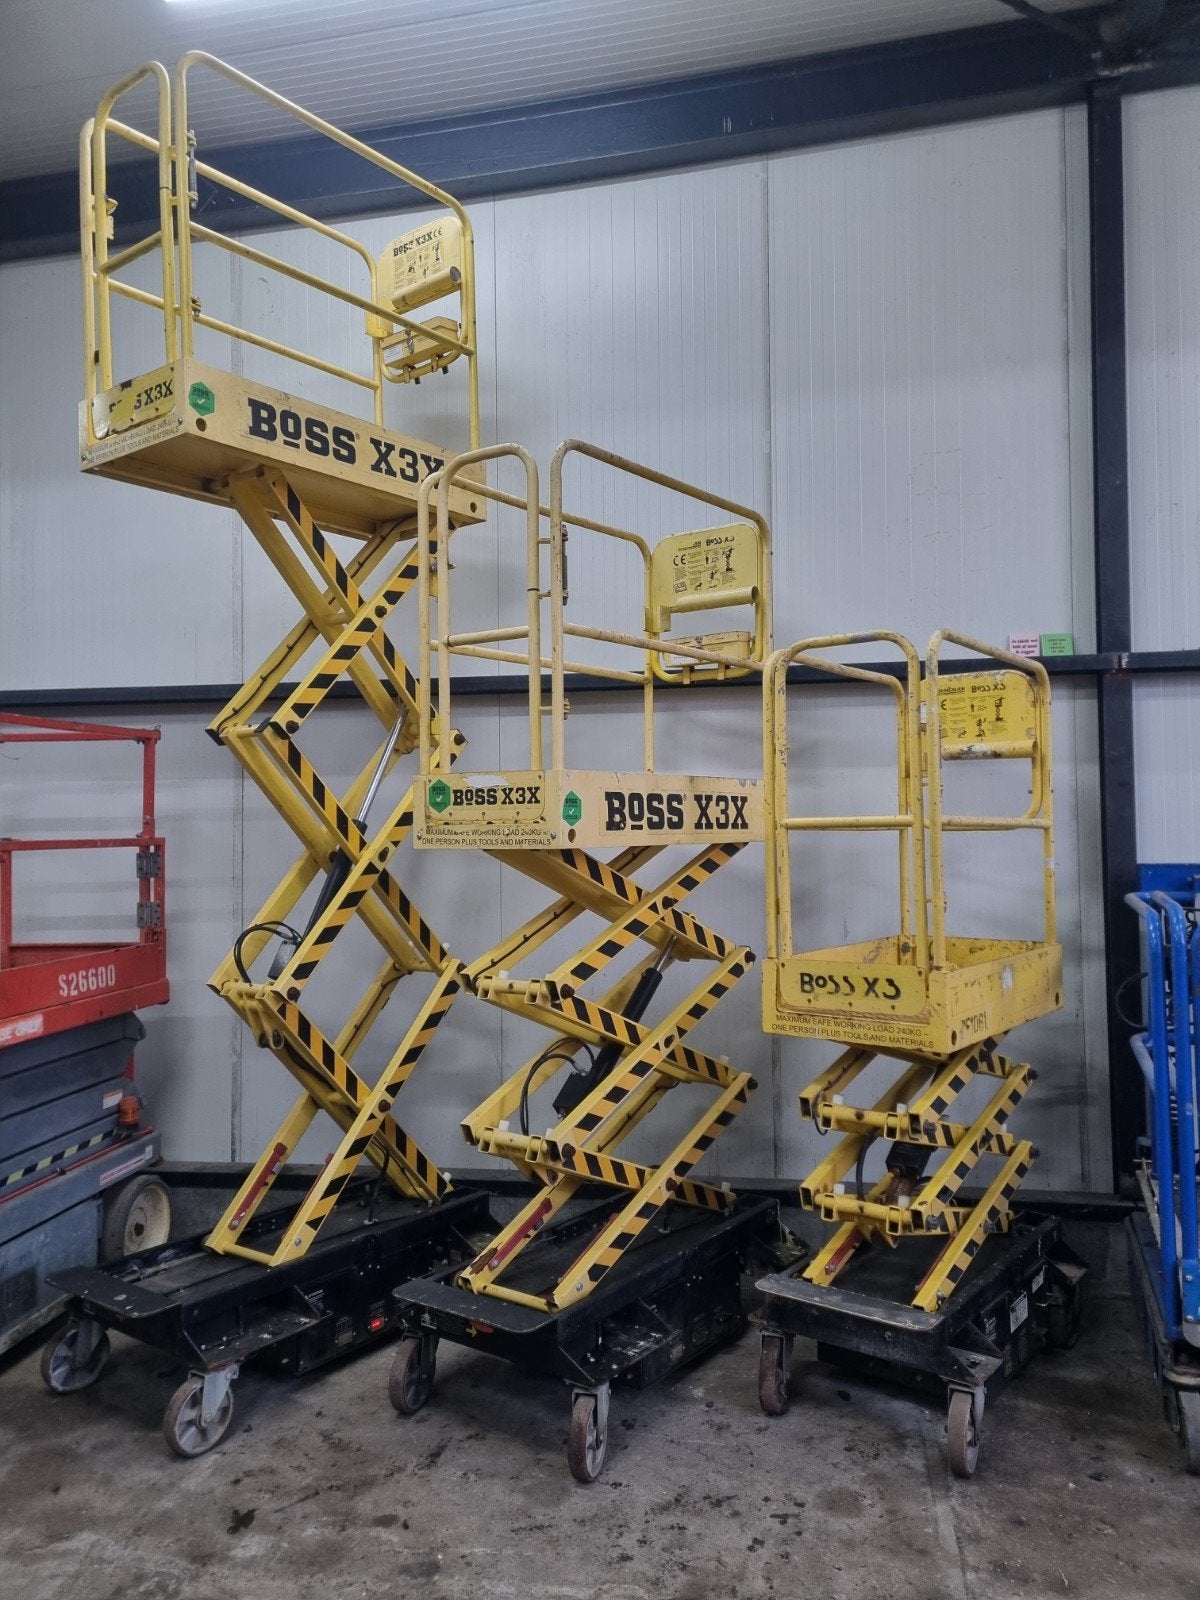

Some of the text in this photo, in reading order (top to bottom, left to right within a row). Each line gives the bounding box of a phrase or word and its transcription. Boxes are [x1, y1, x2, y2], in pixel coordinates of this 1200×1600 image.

[501, 787, 541, 805] X3X
[693, 794, 749, 830] X3X
[461, 838, 478, 846] PLUS
[479, 838, 499, 846] TOOLS
[500, 838, 514, 846] AND
[514, 838, 551, 846] MATERIALS
[58, 964, 116, 997] S26600
[771, 1024, 934, 1049] ONE PERSON PLUS TOOLS AND MATERIALS
[776, 1014, 810, 1025] MAXIMUM
[812, 1018, 832, 1027] SAFE
[833, 1020, 871, 1032] WORKING
[873, 1025, 894, 1034] LOAD
[896, 1027, 922, 1037] 240KG
